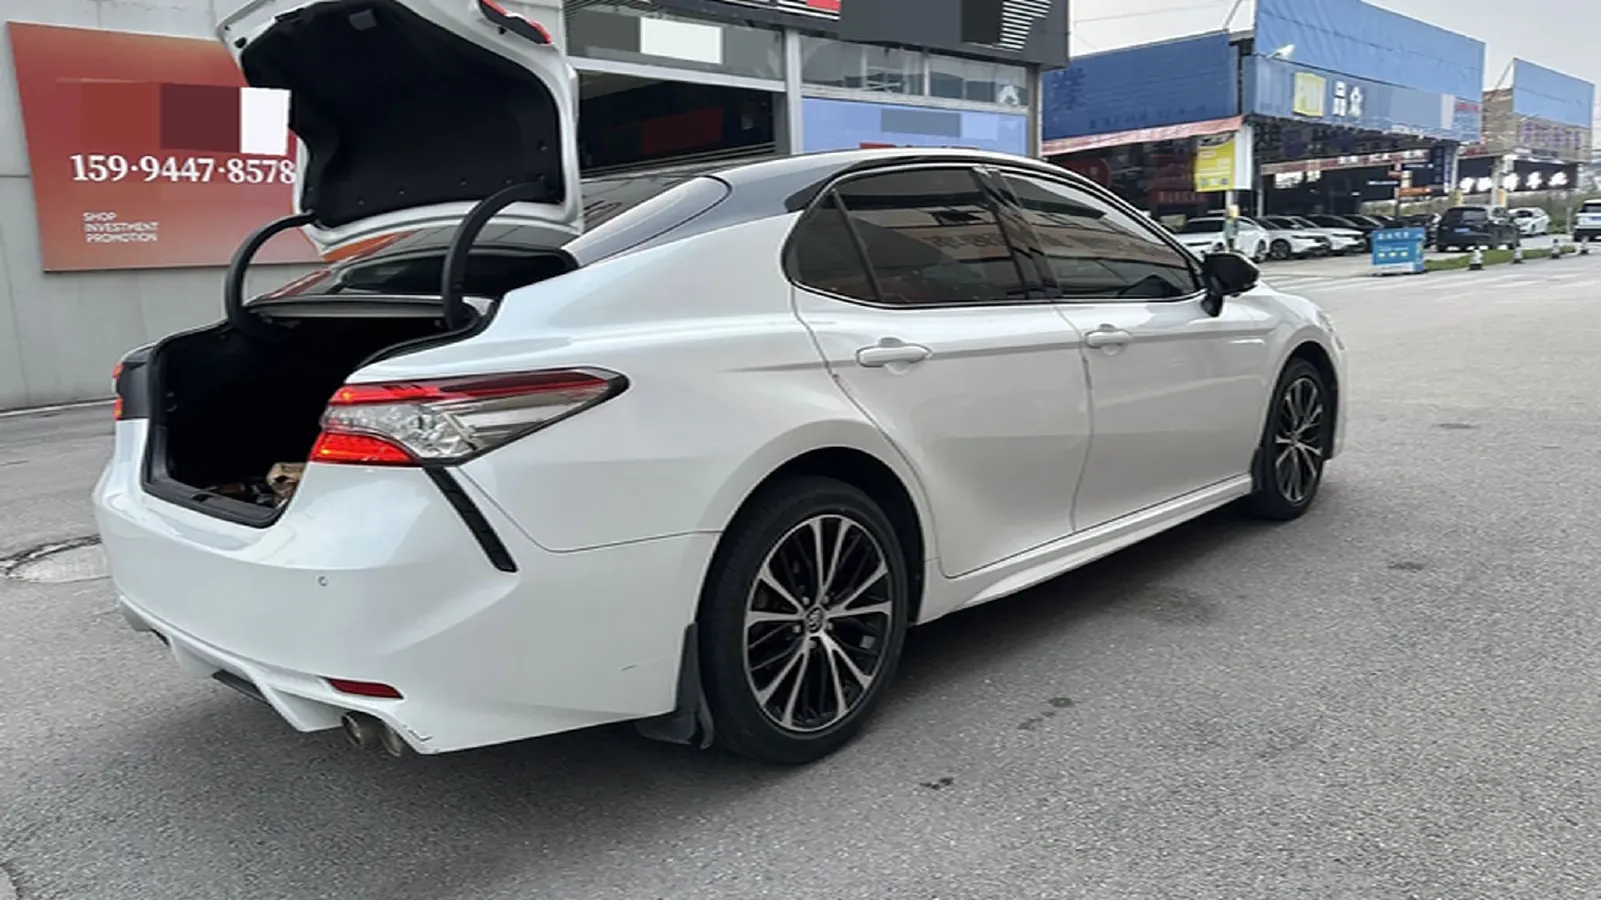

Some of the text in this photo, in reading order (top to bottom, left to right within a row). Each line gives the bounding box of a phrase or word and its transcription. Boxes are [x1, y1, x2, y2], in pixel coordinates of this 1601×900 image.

[83, 211, 117, 222] SHOP
[84, 222, 159, 232] INVESTMENT
[86, 232, 158, 243] PROMOTION
